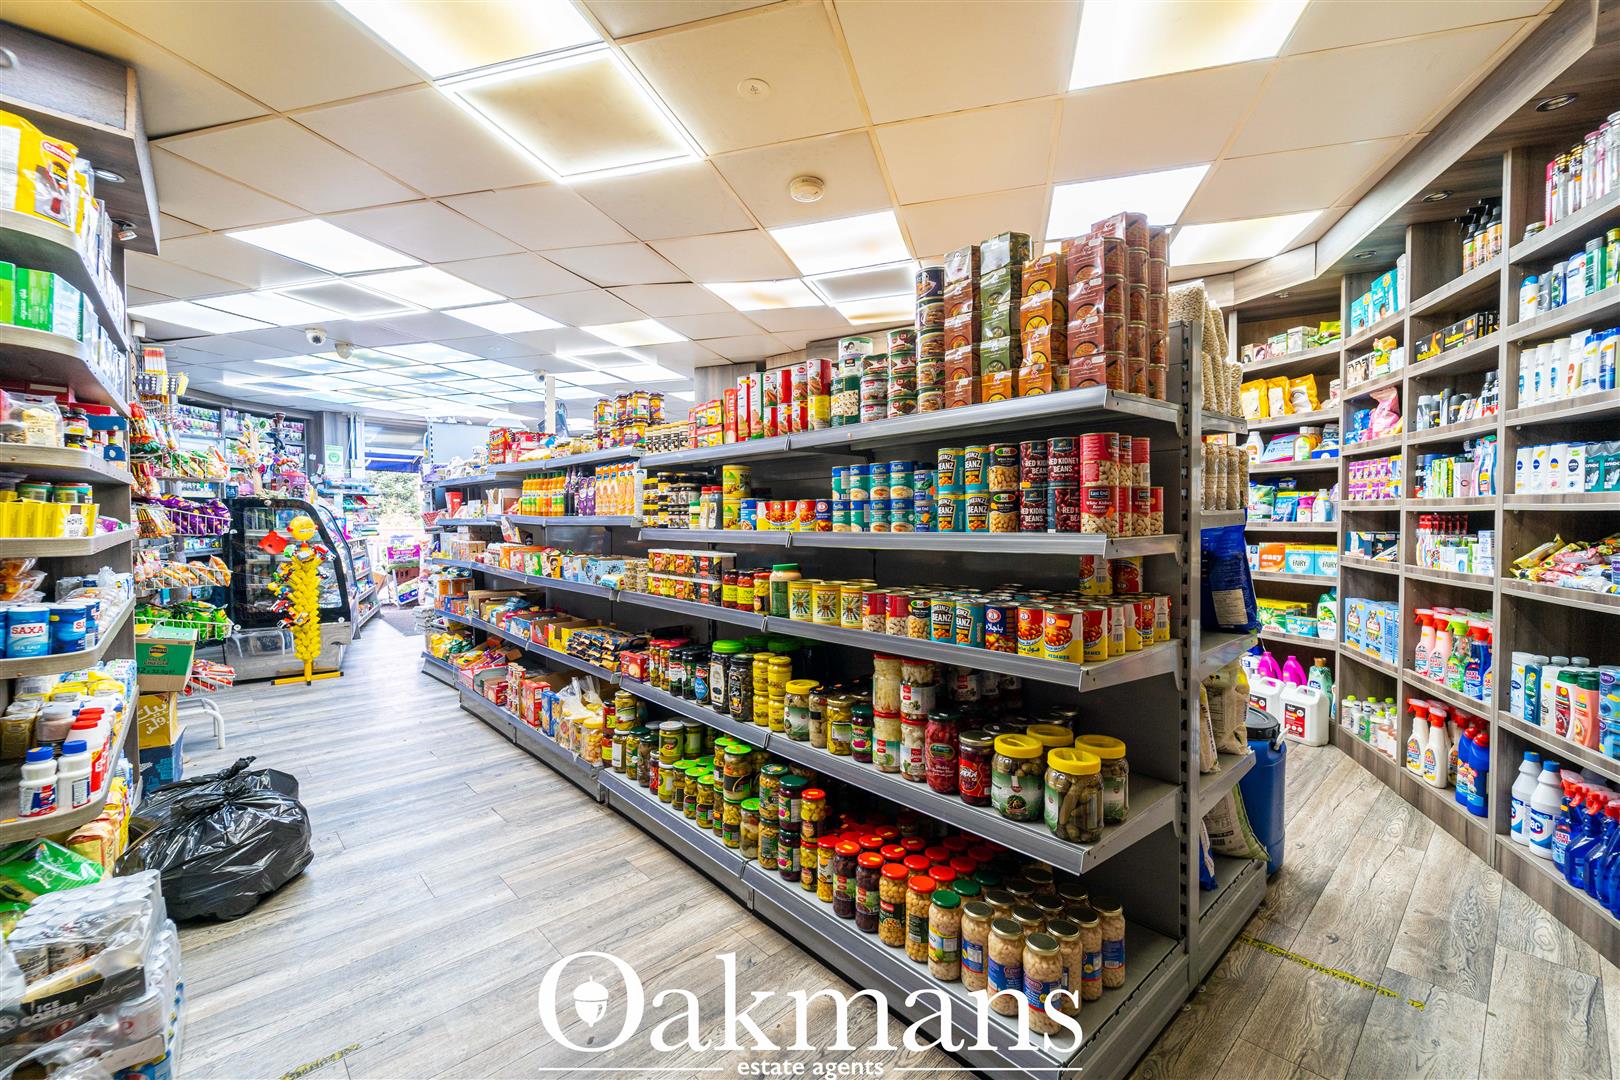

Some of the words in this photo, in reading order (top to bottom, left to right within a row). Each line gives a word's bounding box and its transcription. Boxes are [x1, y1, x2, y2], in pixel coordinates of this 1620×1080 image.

[1053, 465, 1072, 473] BEANS
[1292, 559, 1306, 567] FAIRY
[932, 613, 952, 622] BEANZ
[11, 625, 44, 635] SAXA
[37, 1000, 61, 1014] ICE
[19, 1001, 79, 1028] COFFEE
